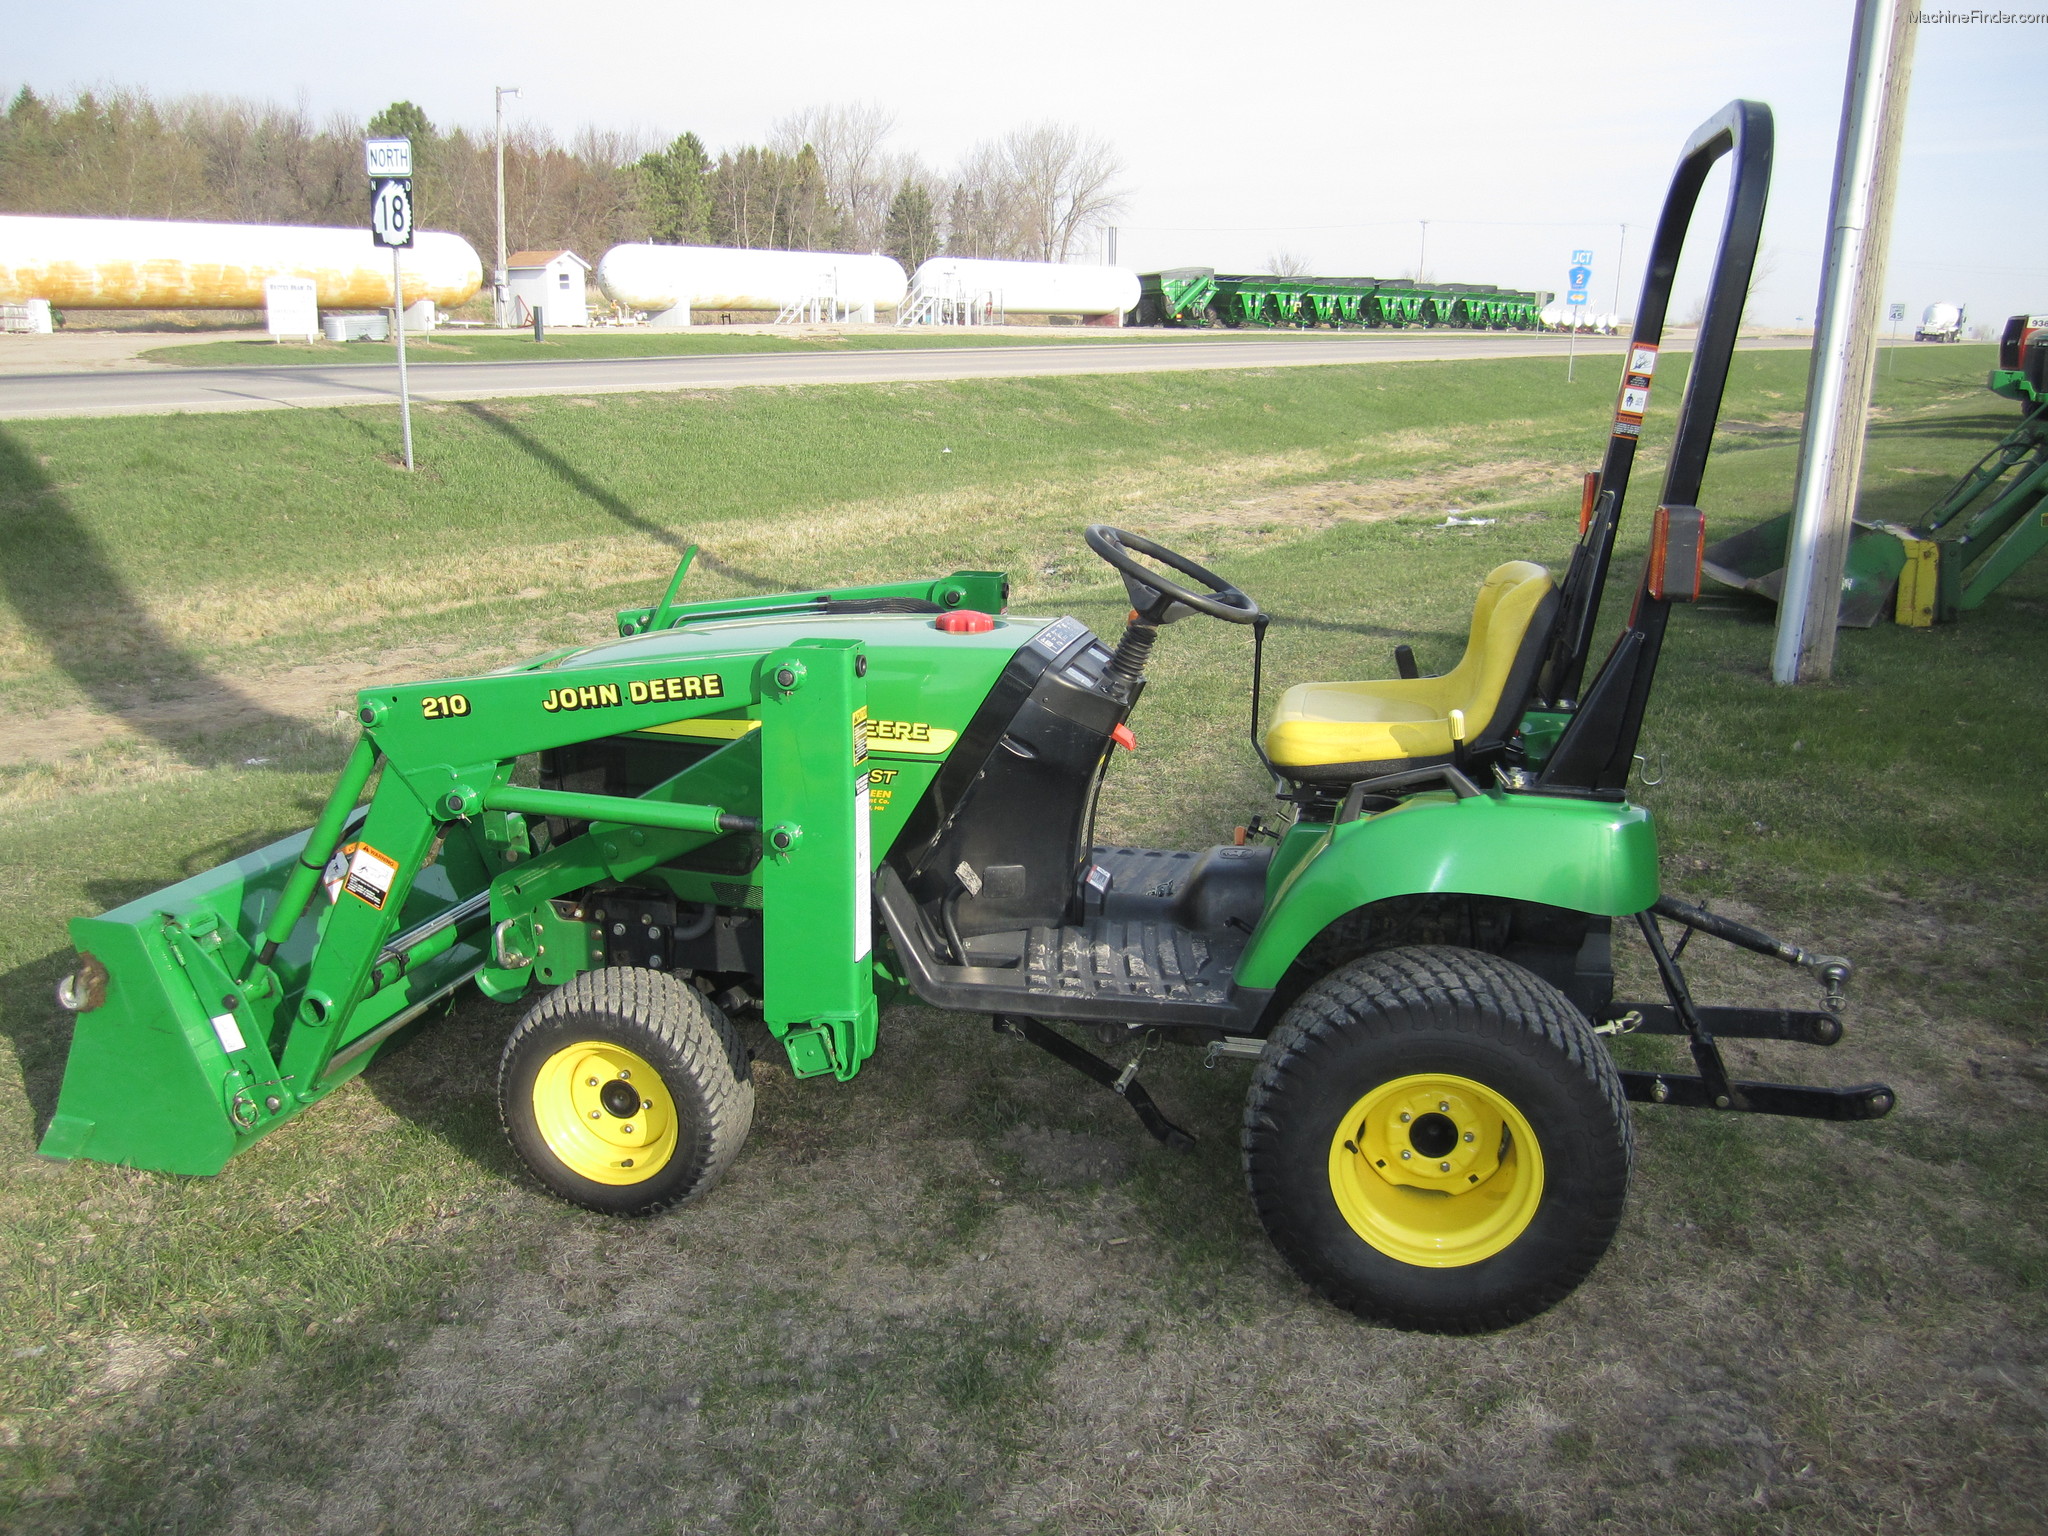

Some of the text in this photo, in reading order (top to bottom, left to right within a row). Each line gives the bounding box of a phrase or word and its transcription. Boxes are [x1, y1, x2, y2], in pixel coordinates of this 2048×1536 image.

[370, 148, 408, 167] NORTH
[371, 180, 411, 191] N D
[382, 195, 404, 232] 18
[1573, 252, 1592, 263] JCT
[1576, 273, 1584, 284] 2
[1891, 312, 1904, 320] 45
[541, 674, 724, 712] JOHN DEERE
[421, 694, 471, 720] 210
[869, 768, 898, 785] ST
